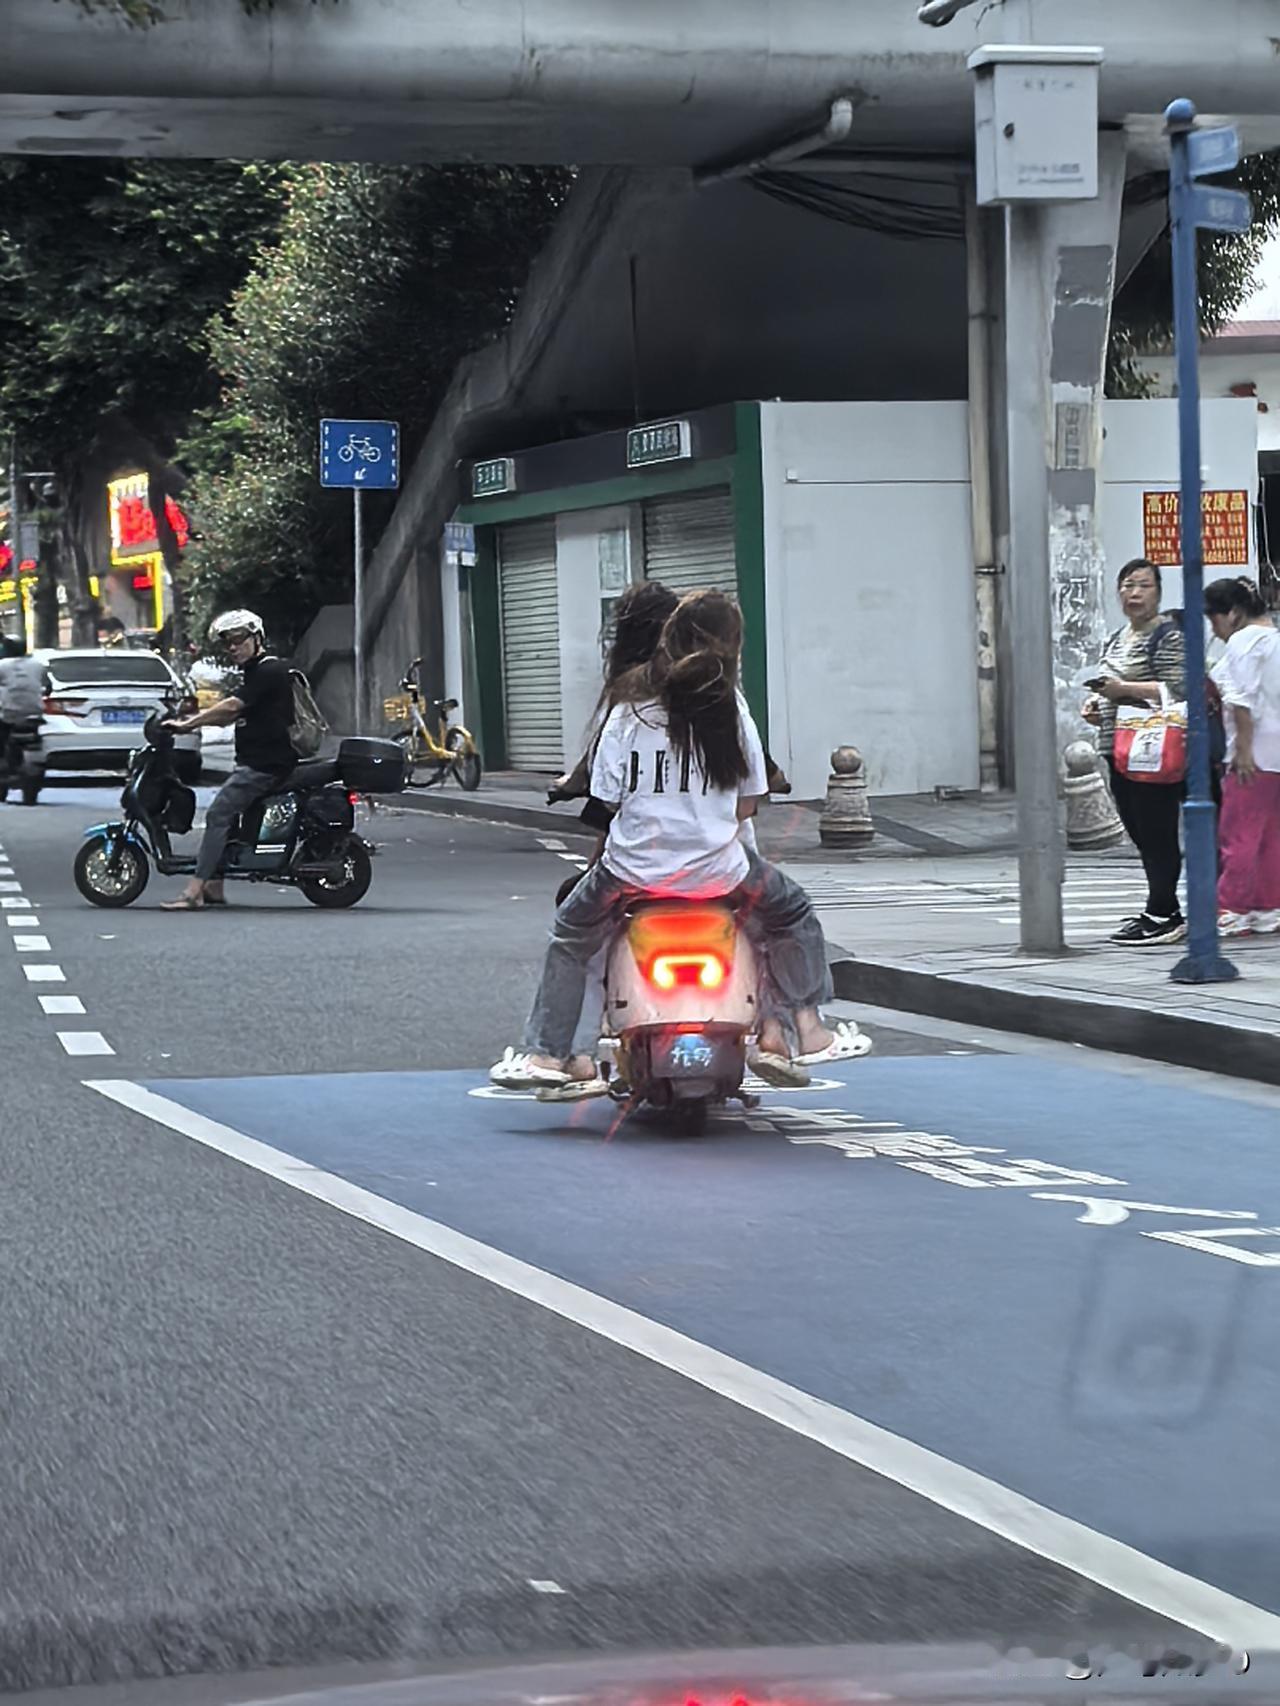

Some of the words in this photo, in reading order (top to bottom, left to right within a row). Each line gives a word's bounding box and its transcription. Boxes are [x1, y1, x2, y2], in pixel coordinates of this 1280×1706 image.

[1147, 492, 1246, 513] 高价收废品
